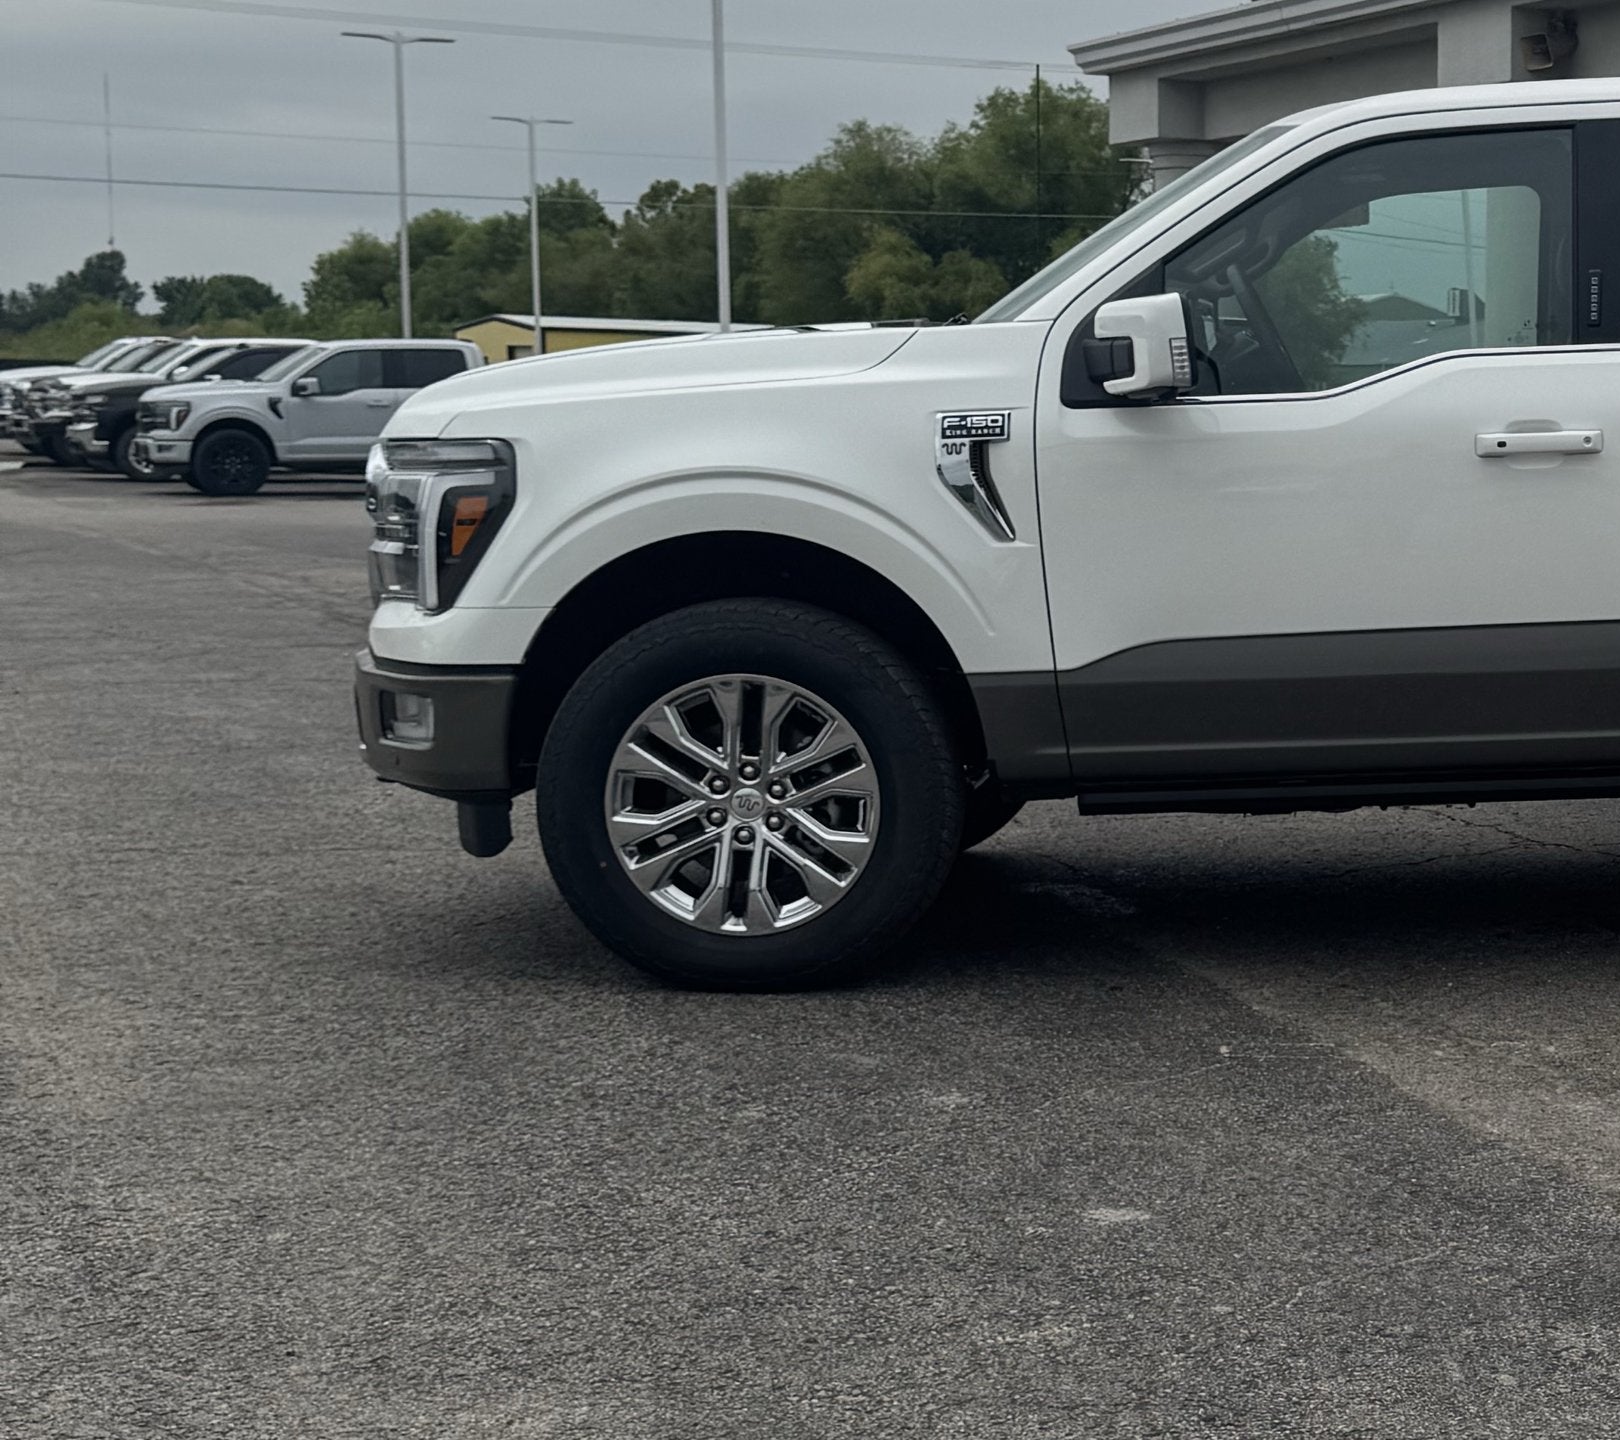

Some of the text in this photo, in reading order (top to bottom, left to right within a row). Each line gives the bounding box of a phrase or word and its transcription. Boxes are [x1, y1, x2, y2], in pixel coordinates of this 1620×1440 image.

[943, 415, 1003, 428] F-150
[945, 427, 1001, 436] KING RANCH
